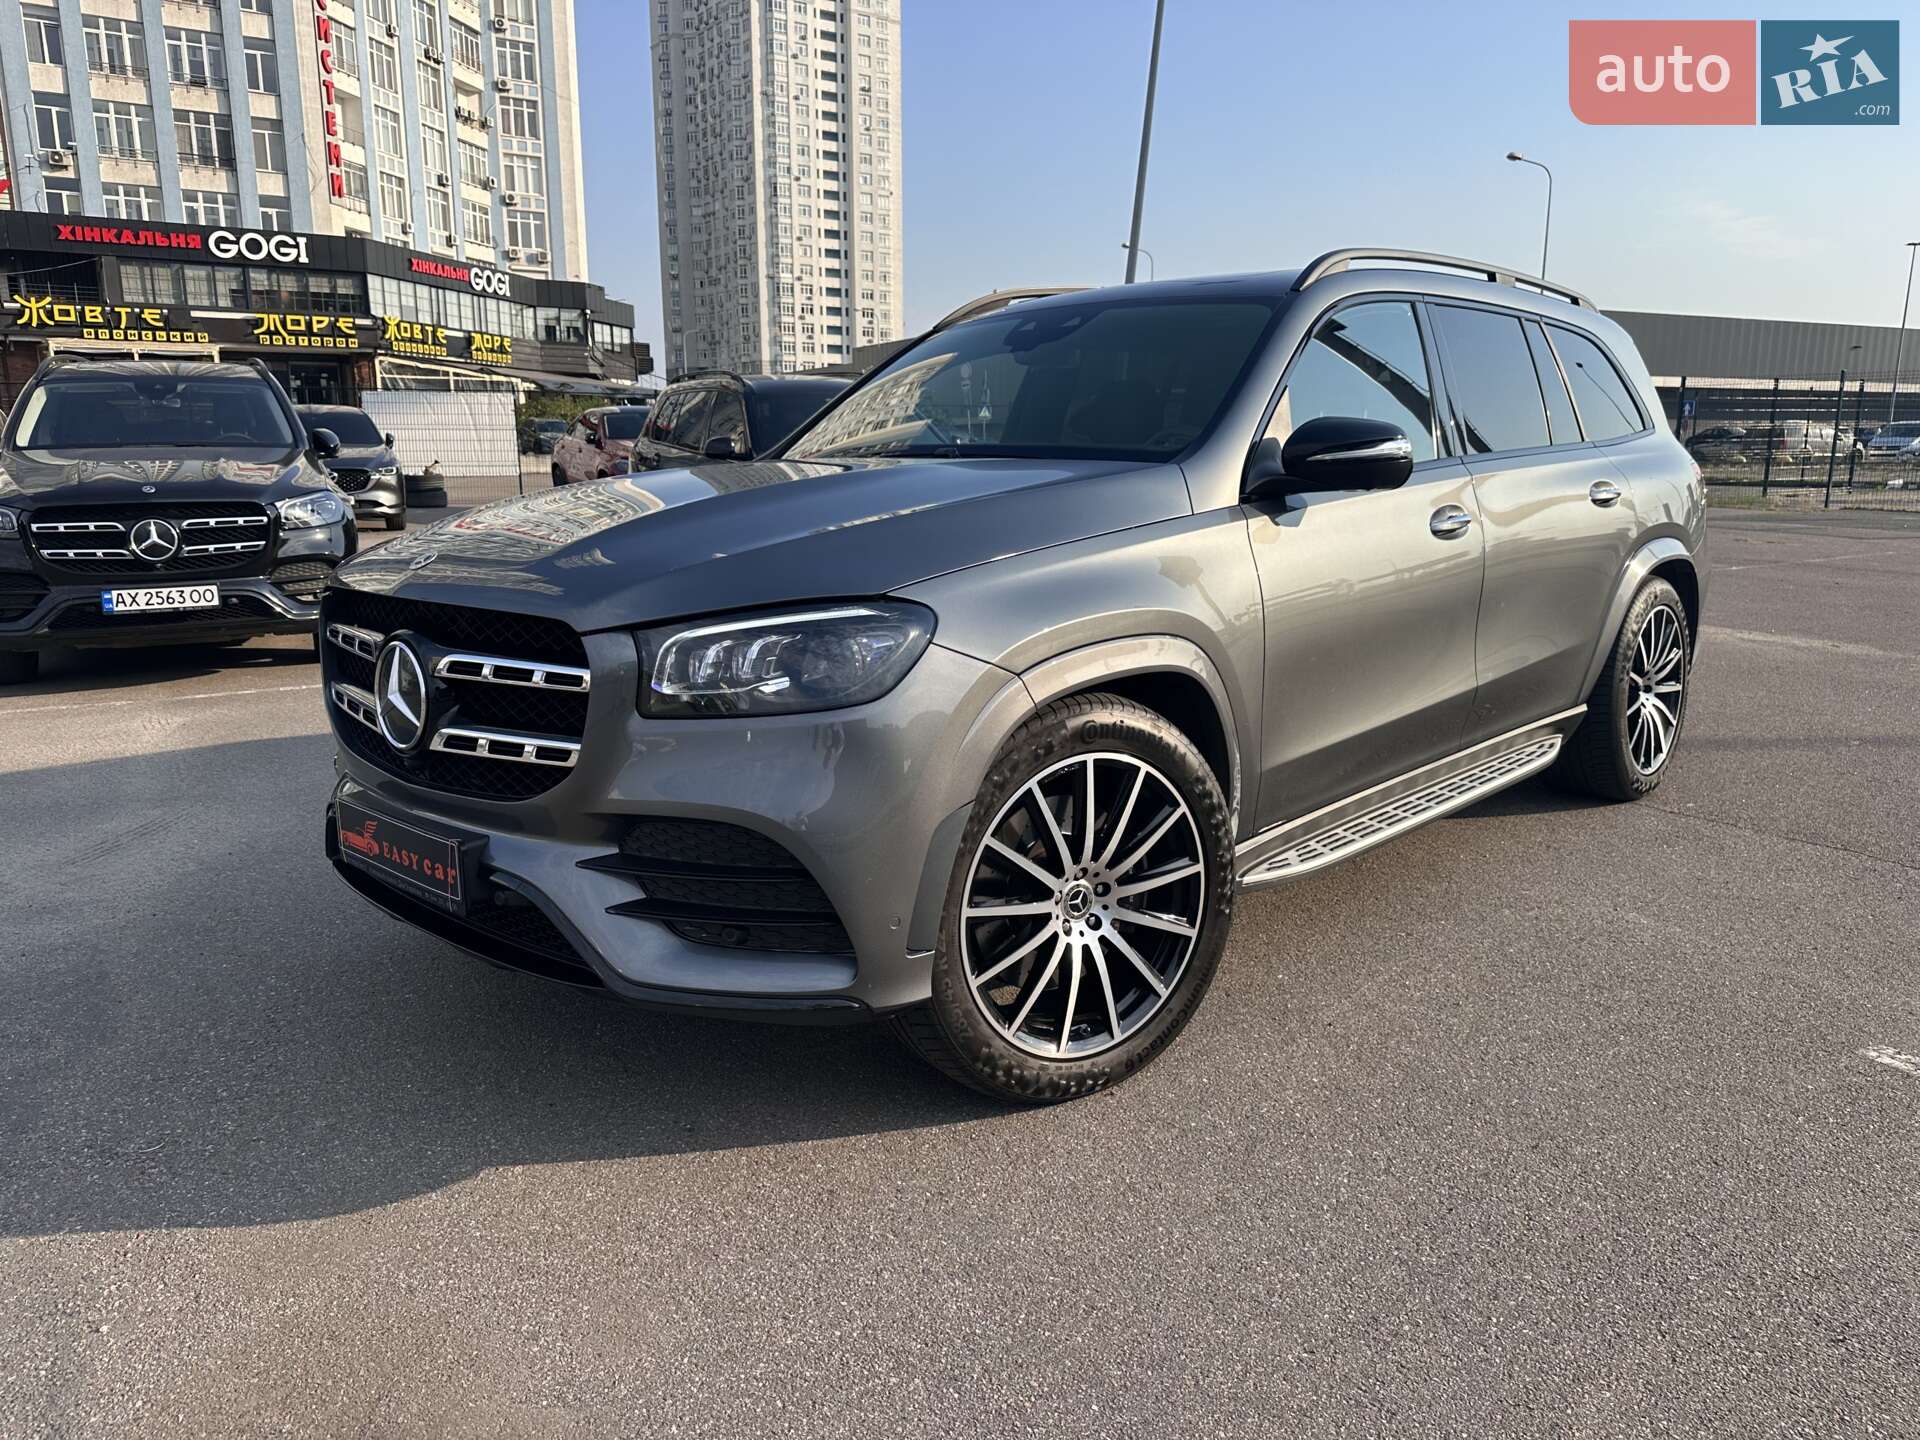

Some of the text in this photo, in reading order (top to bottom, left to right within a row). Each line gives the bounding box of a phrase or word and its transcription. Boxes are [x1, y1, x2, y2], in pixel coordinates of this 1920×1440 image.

[56, 224, 202, 249] ХІНКАЛЬНЯ
[208, 230, 309, 264] GOGI
[410, 257, 469, 283] ХІНКАЛЬНЯ
[470, 267, 511, 297] GOGI
[13, 295, 168, 328] ЖОВТЕ
[253, 313, 356, 338] МОРЕ
[383, 315, 447, 345] ЖОВТЕ
[470, 332, 512, 353] МОРЕ
[115, 592, 141, 608] AX
[144, 590, 186, 606] 2563
[383, 841, 419, 871] EASY
